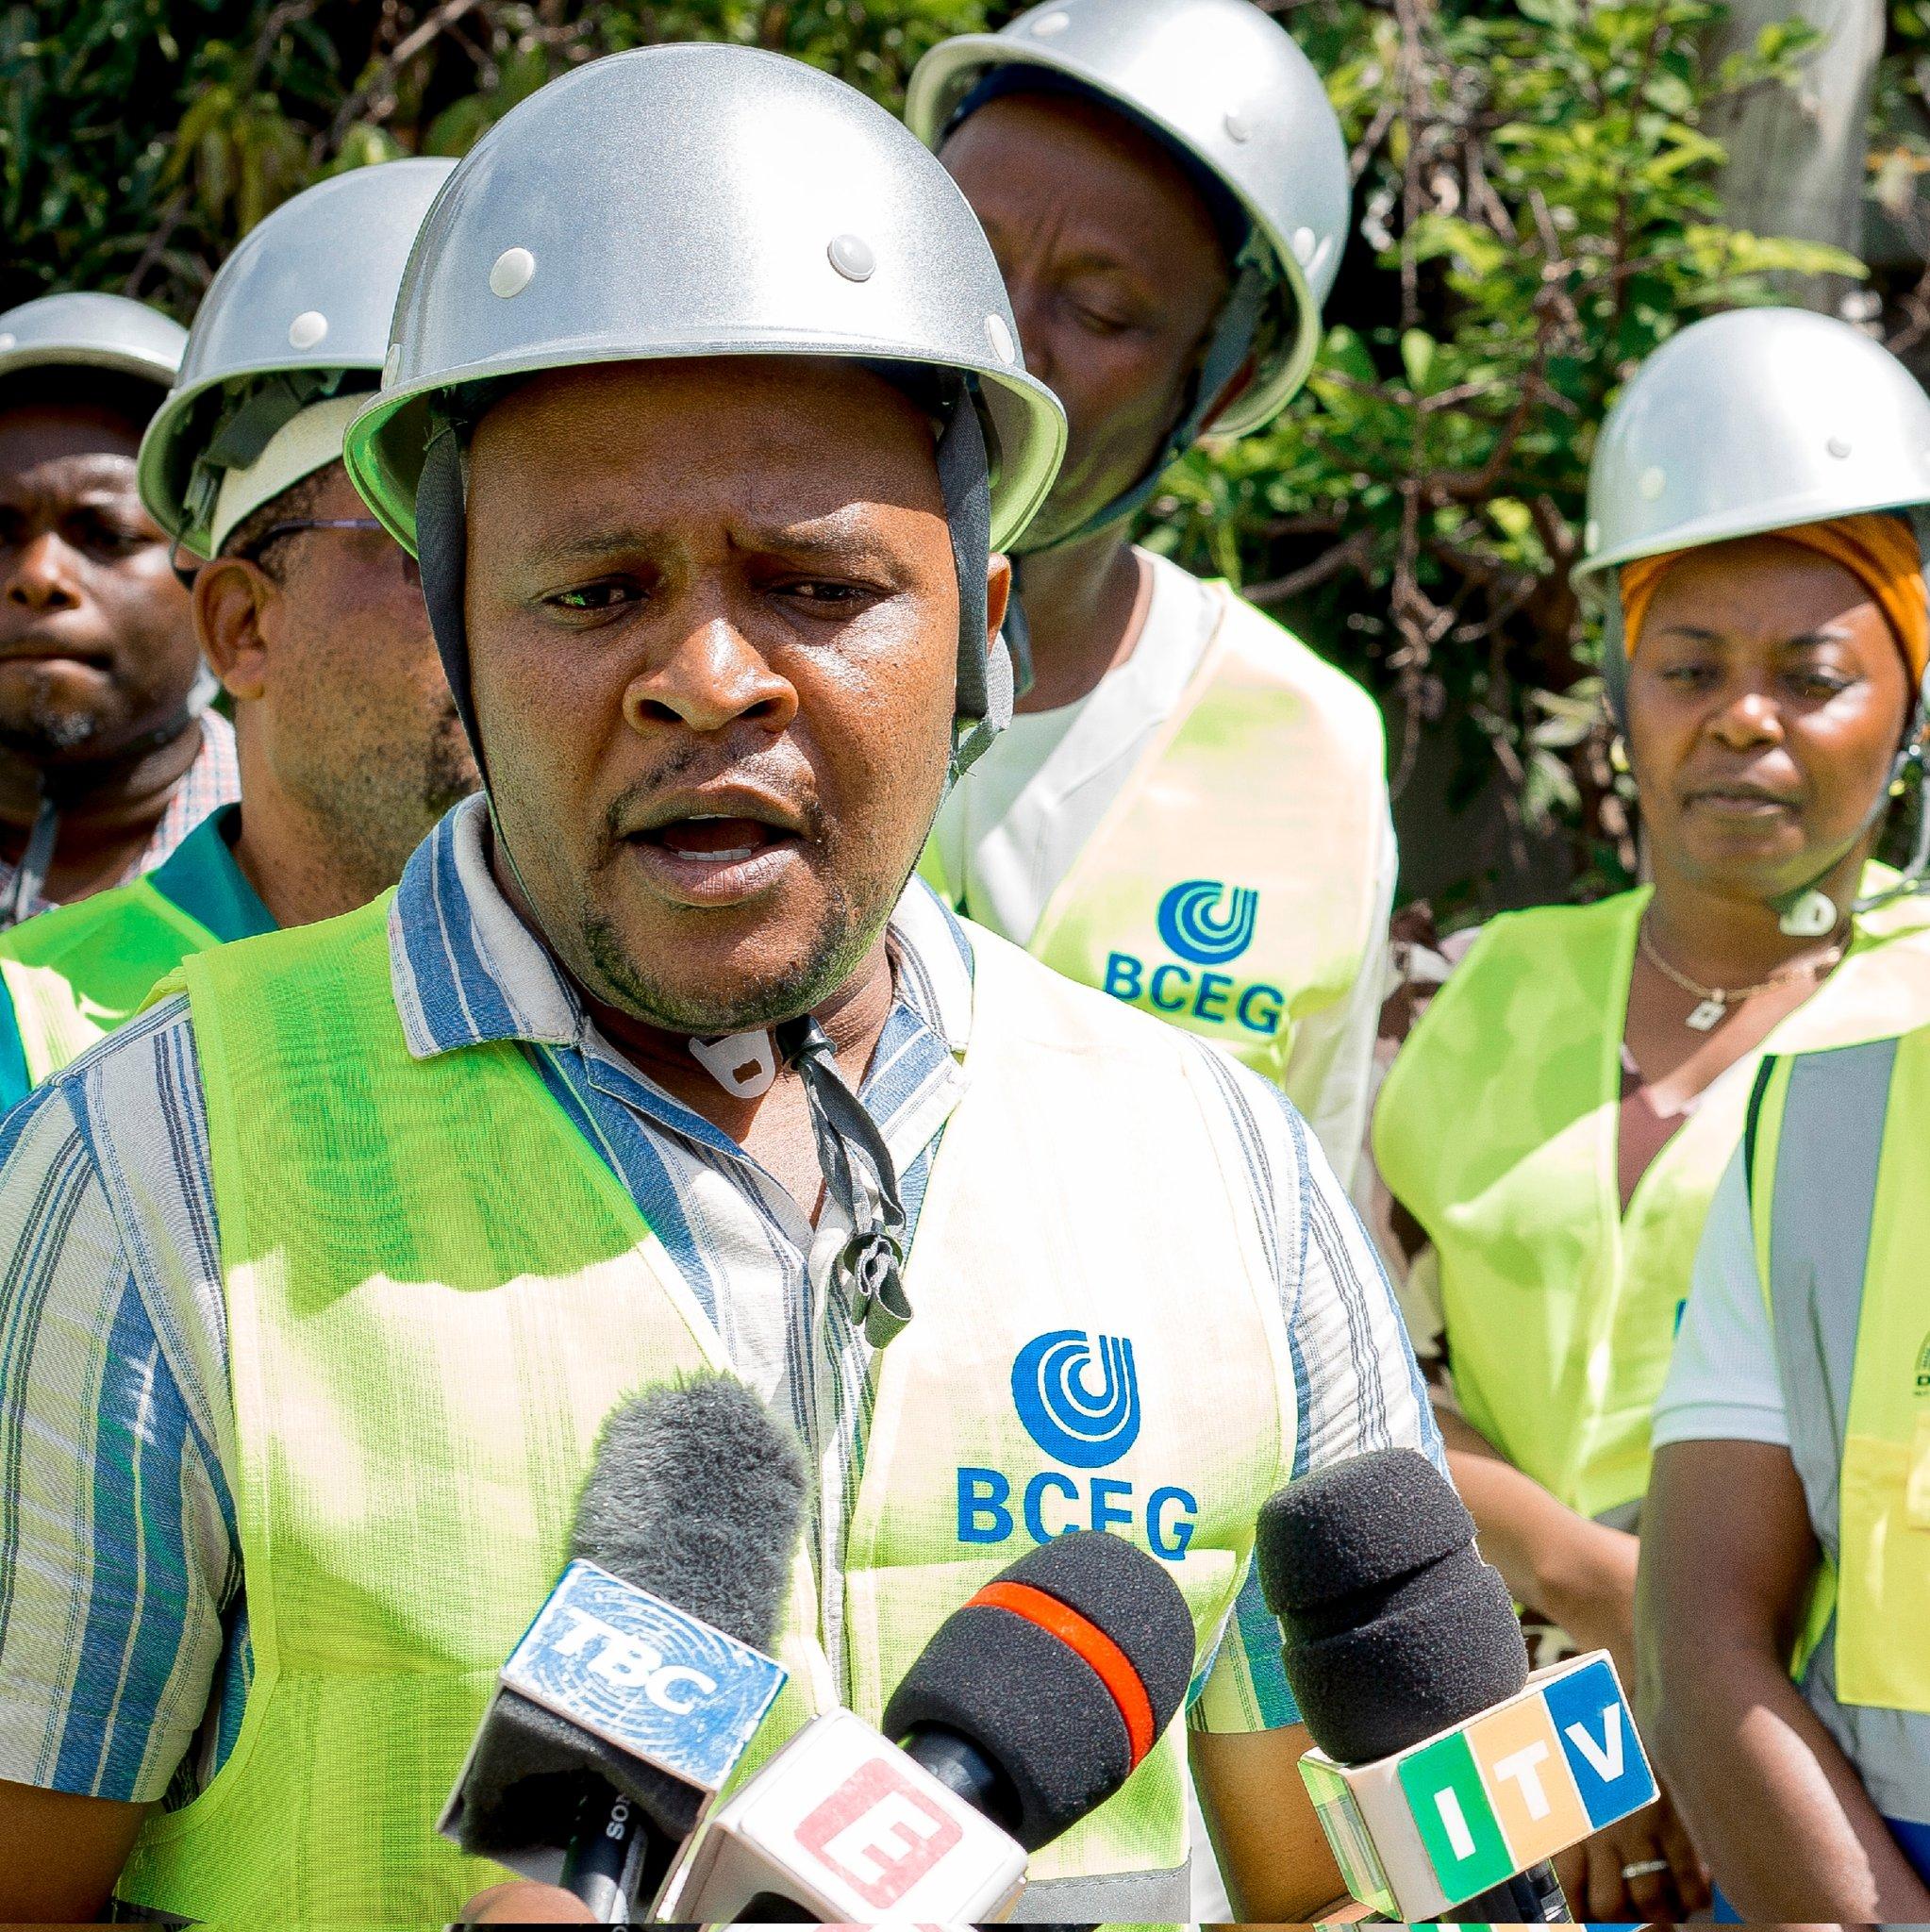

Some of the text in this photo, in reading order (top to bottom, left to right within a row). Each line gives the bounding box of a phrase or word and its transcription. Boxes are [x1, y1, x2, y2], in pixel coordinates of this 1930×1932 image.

[1105, 953, 1285, 1035] BCEG
[957, 1467, 1198, 1561] BCEG
[551, 1606, 718, 1716] TBC
[1433, 1701, 1624, 1861] ITV
[820, 1790, 943, 1885] E
